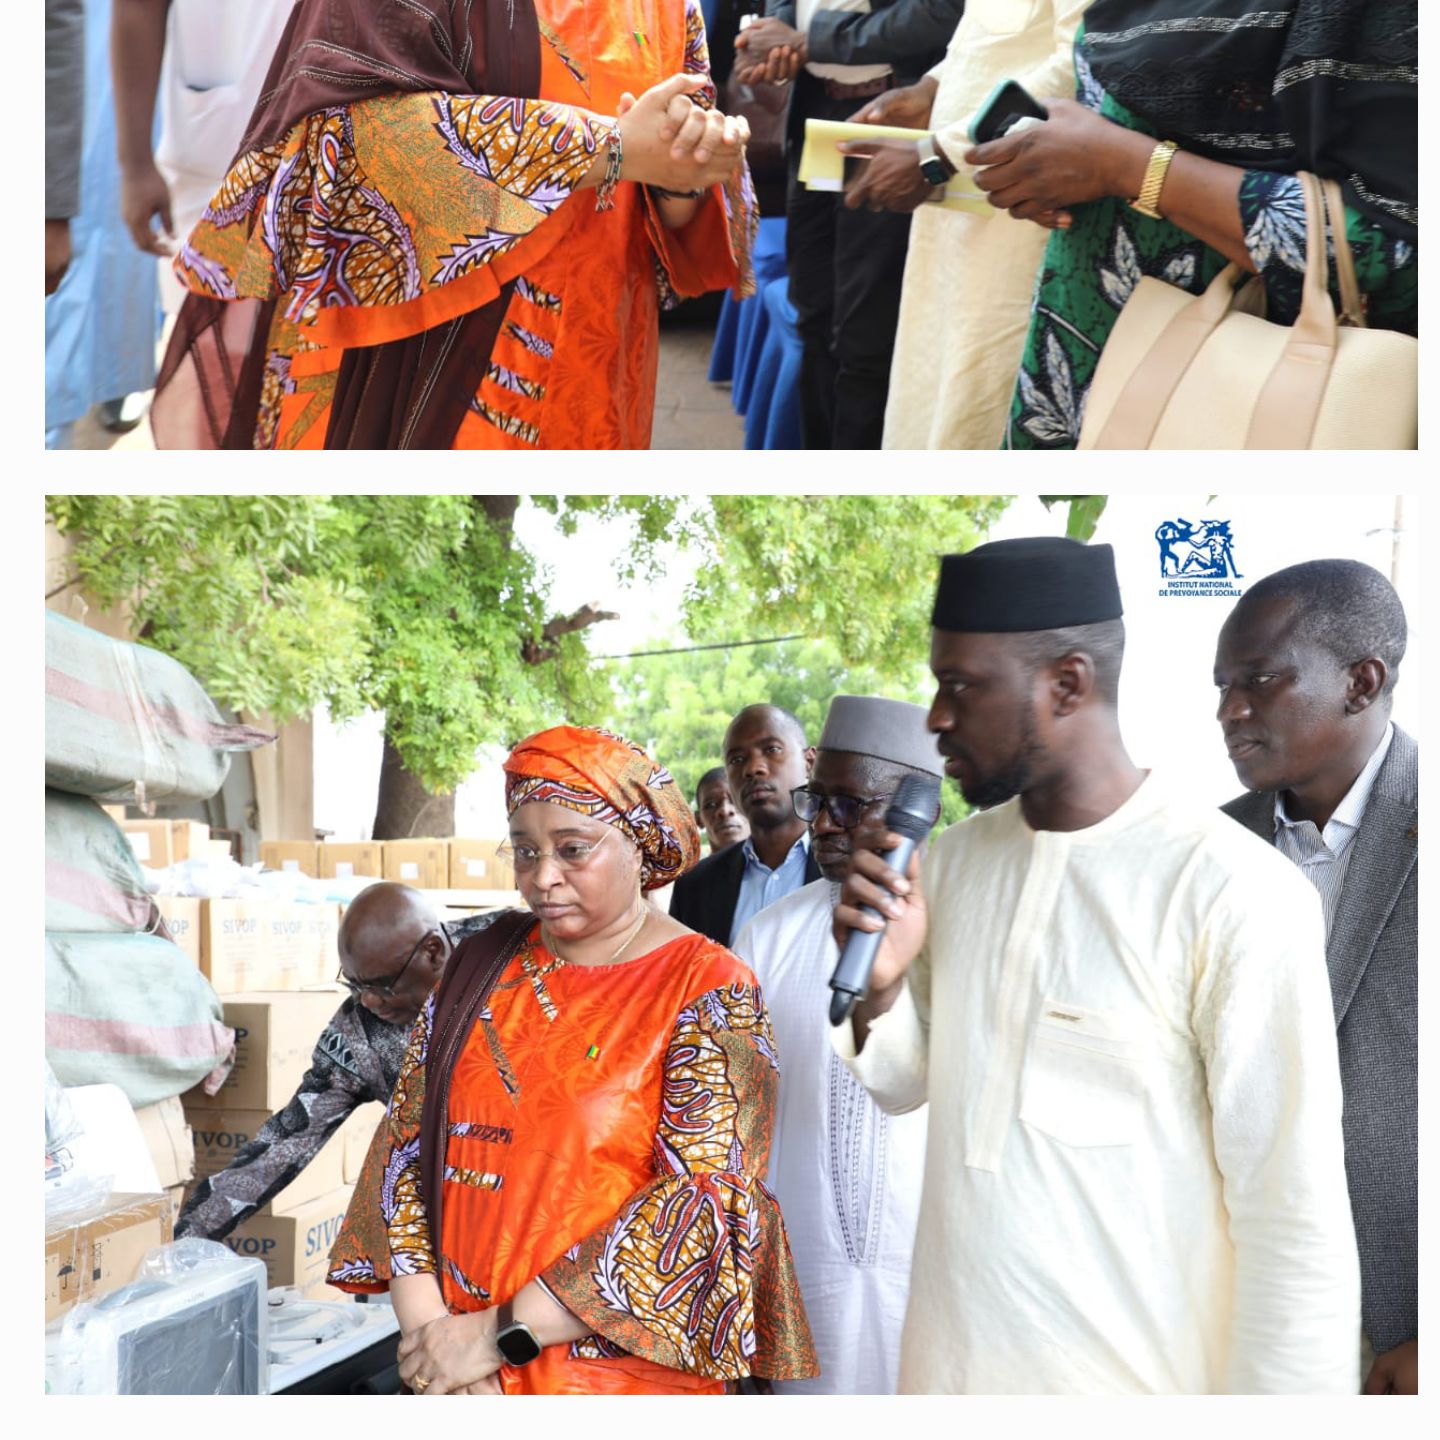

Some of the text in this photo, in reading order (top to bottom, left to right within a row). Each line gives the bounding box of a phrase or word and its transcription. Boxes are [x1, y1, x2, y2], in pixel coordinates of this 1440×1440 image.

[223, 919, 256, 934] SIVOP
[272, 921, 302, 935] SIVOP
[193, 1131, 248, 1148] IVOP
[305, 1213, 346, 1257] SIVO
[226, 1237, 276, 1255] VOP
